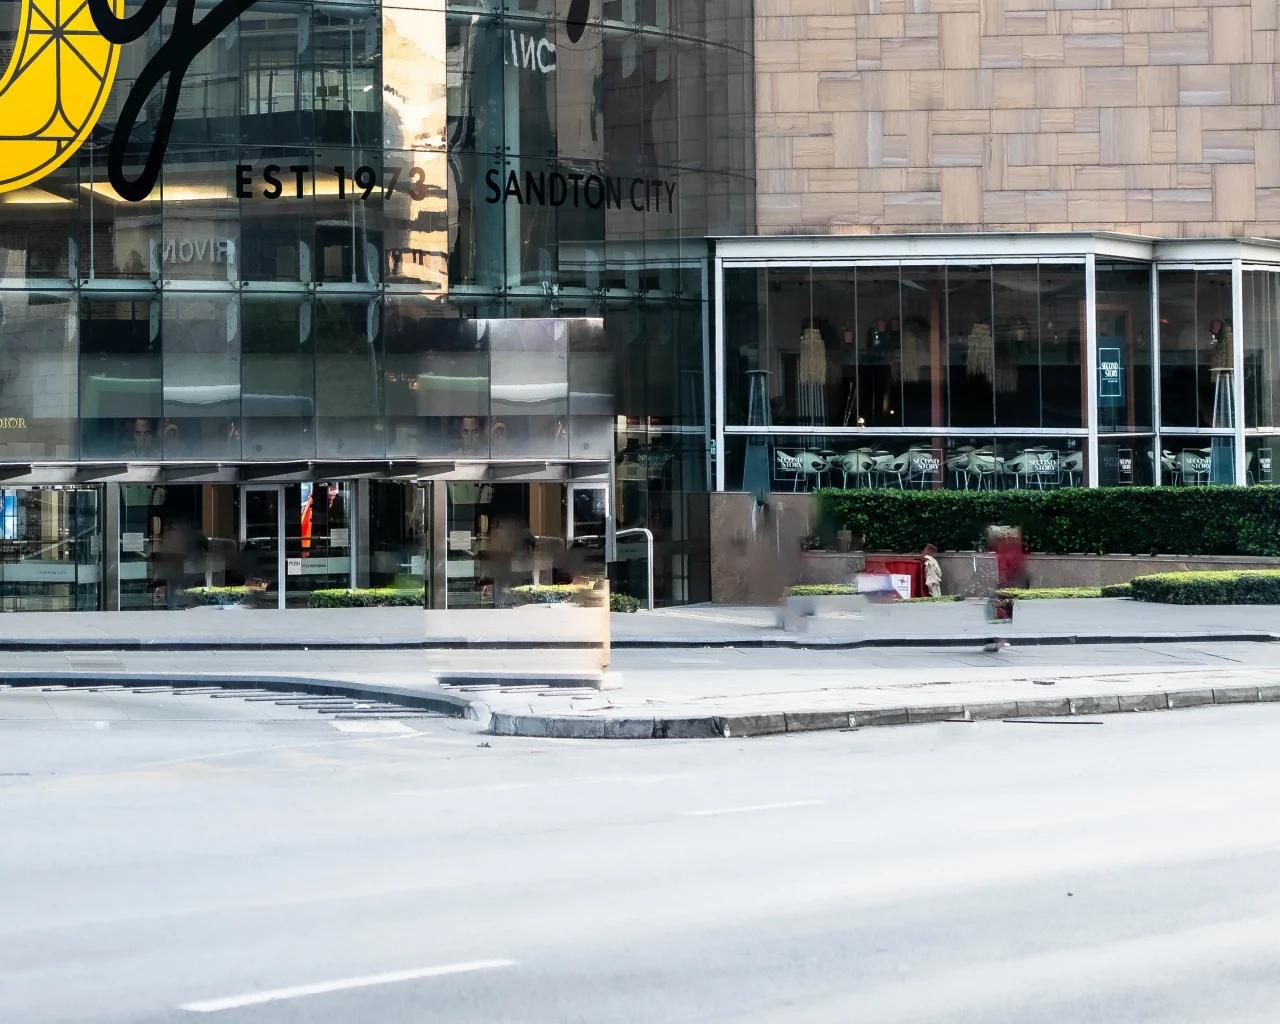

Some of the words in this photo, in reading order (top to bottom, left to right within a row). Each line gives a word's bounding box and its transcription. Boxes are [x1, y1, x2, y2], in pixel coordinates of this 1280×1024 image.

[235, 164, 310, 200] EST
[333, 165, 427, 202] 1973
[485, 168, 623, 210] SANDTON
[630, 177, 678, 215] CITY
